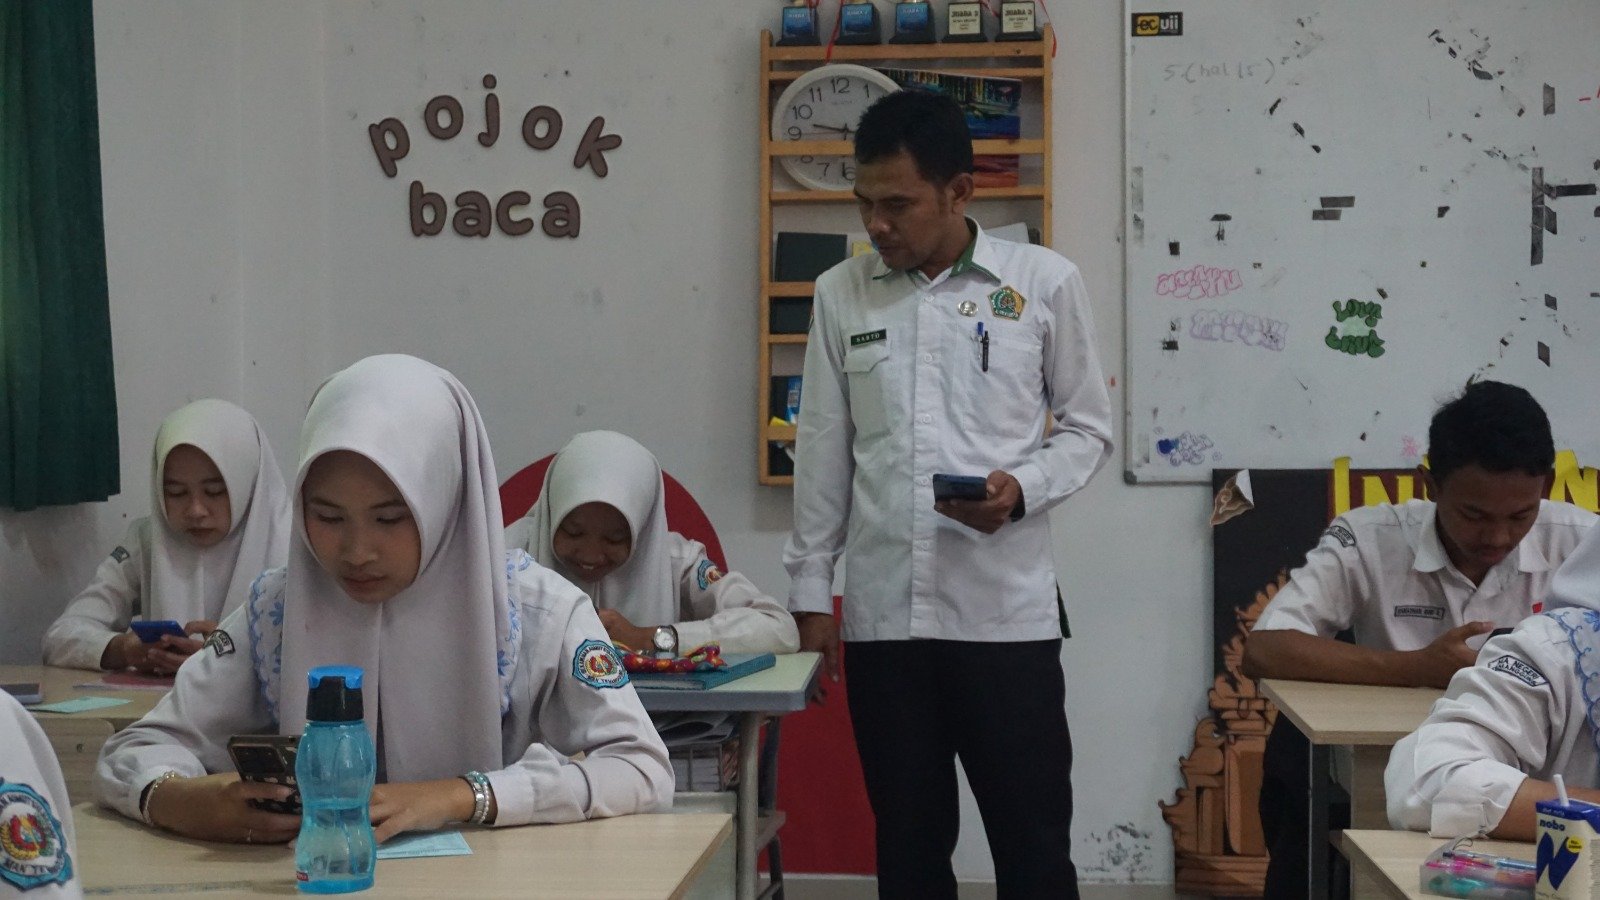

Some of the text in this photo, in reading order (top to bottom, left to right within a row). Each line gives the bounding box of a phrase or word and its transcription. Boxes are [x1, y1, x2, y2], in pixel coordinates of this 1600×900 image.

[951, 10, 973, 18] JUARA
[831, 78, 850, 94] 12
[809, 87, 823, 103] 11
[793, 104, 813, 120] 10
[368, 74, 623, 178] pojok
[788, 126, 801, 141] 9
[817, 162, 830, 177] 7
[409, 180, 581, 238] baca
[1513, 660, 1541, 680] NEGERI
[1539, 819, 1566, 832] nobo
